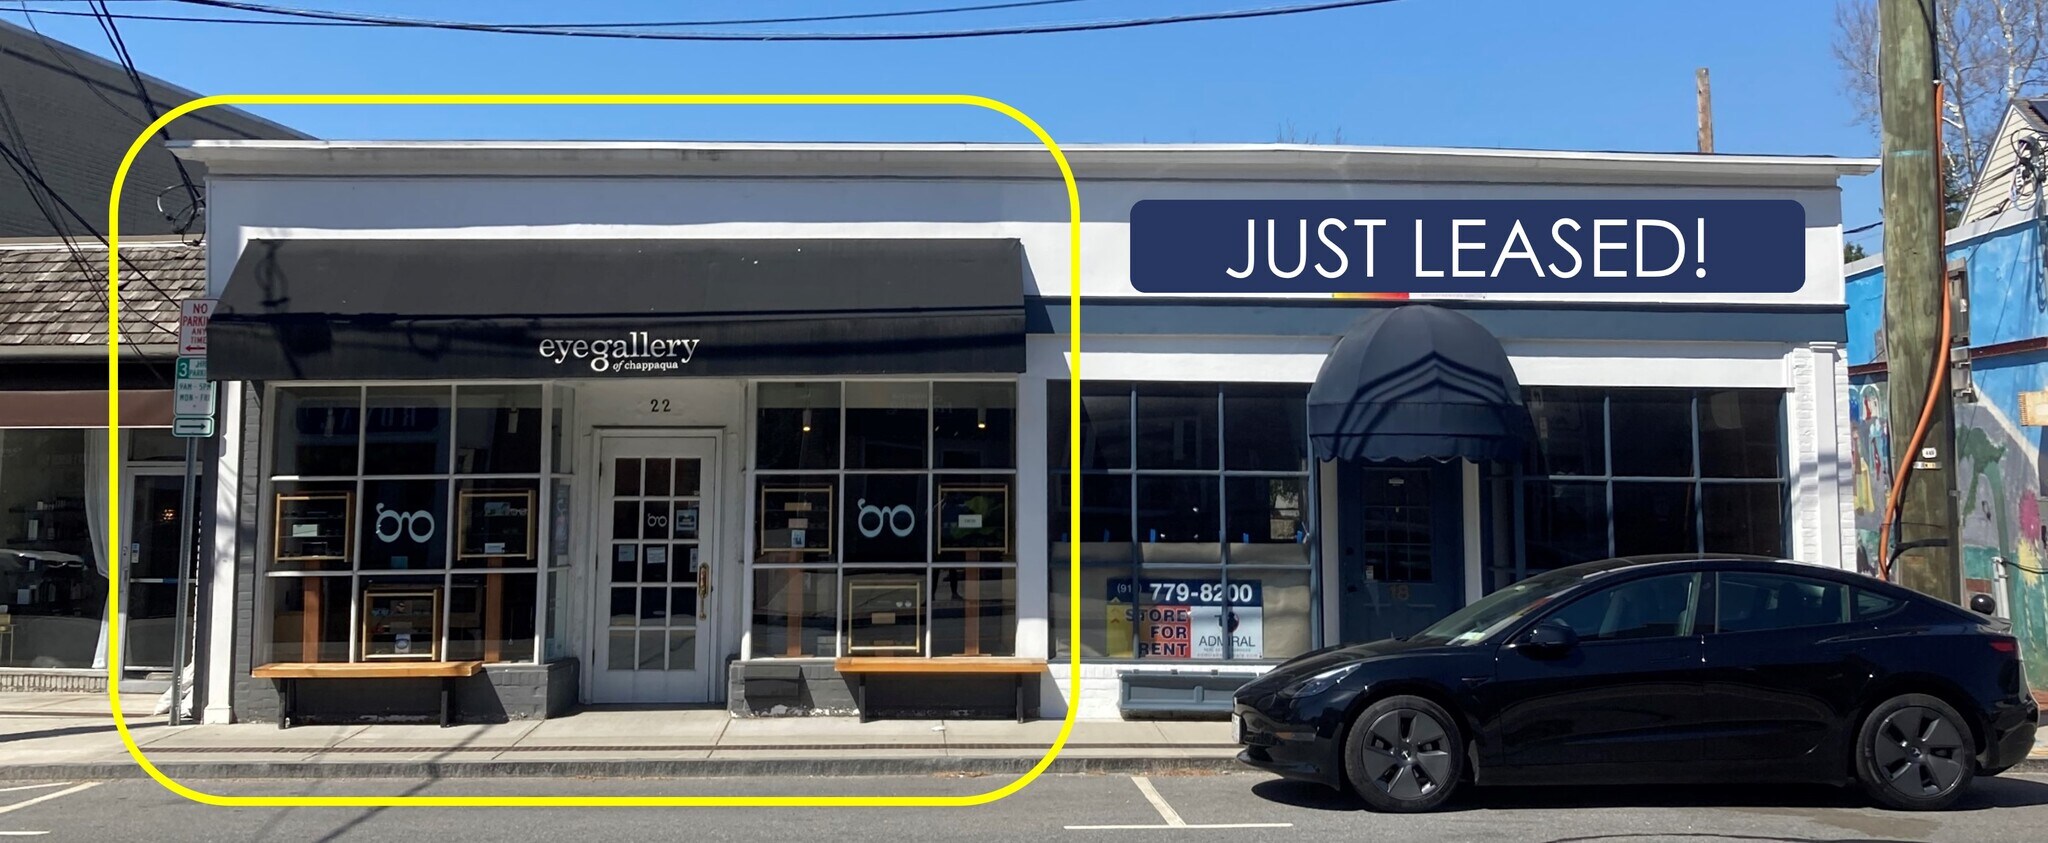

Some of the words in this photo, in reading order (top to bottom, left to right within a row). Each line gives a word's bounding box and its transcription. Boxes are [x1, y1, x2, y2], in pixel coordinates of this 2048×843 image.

[193, 303, 208, 314] NO
[183, 316, 209, 326] PARKI
[192, 328, 207, 336] ANY
[190, 336, 207, 344] TIME
[539, 331, 700, 372] eyegallery
[179, 362, 188, 377] 3
[612, 360, 624, 372] of
[624, 360, 679, 372] chappaqua
[179, 394, 194, 402] MON
[199, 394, 210, 402] FRI
[650, 399, 671, 412] 22
[1117, 583, 1142, 593] (91)
[1149, 583, 1253, 603] 779-8200
[1125, 609, 1188, 622] STORE
[1150, 626, 1188, 639] FOR
[1139, 643, 1188, 656] RENT
